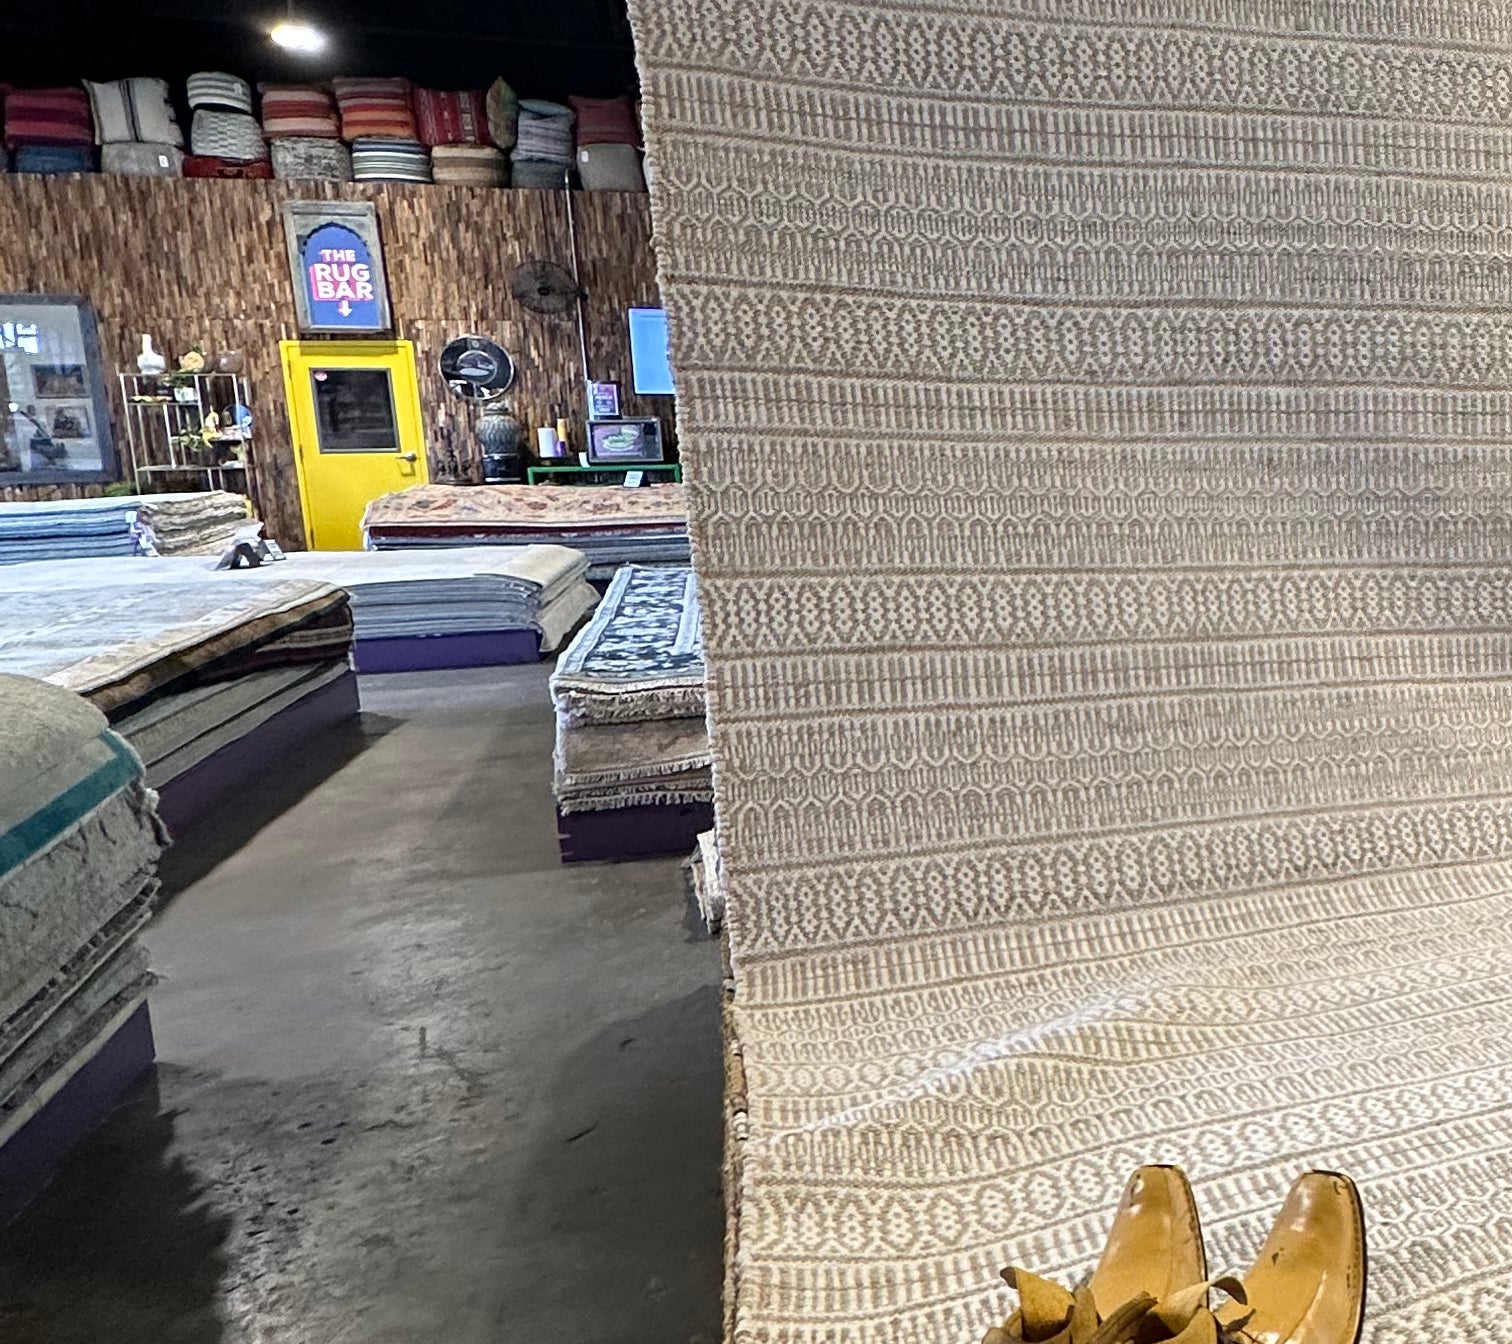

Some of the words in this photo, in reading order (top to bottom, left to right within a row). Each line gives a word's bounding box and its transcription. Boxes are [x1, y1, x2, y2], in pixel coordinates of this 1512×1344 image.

[319, 249, 356, 262] THE
[313, 263, 371, 282] RUG
[316, 281, 374, 300] BAR
